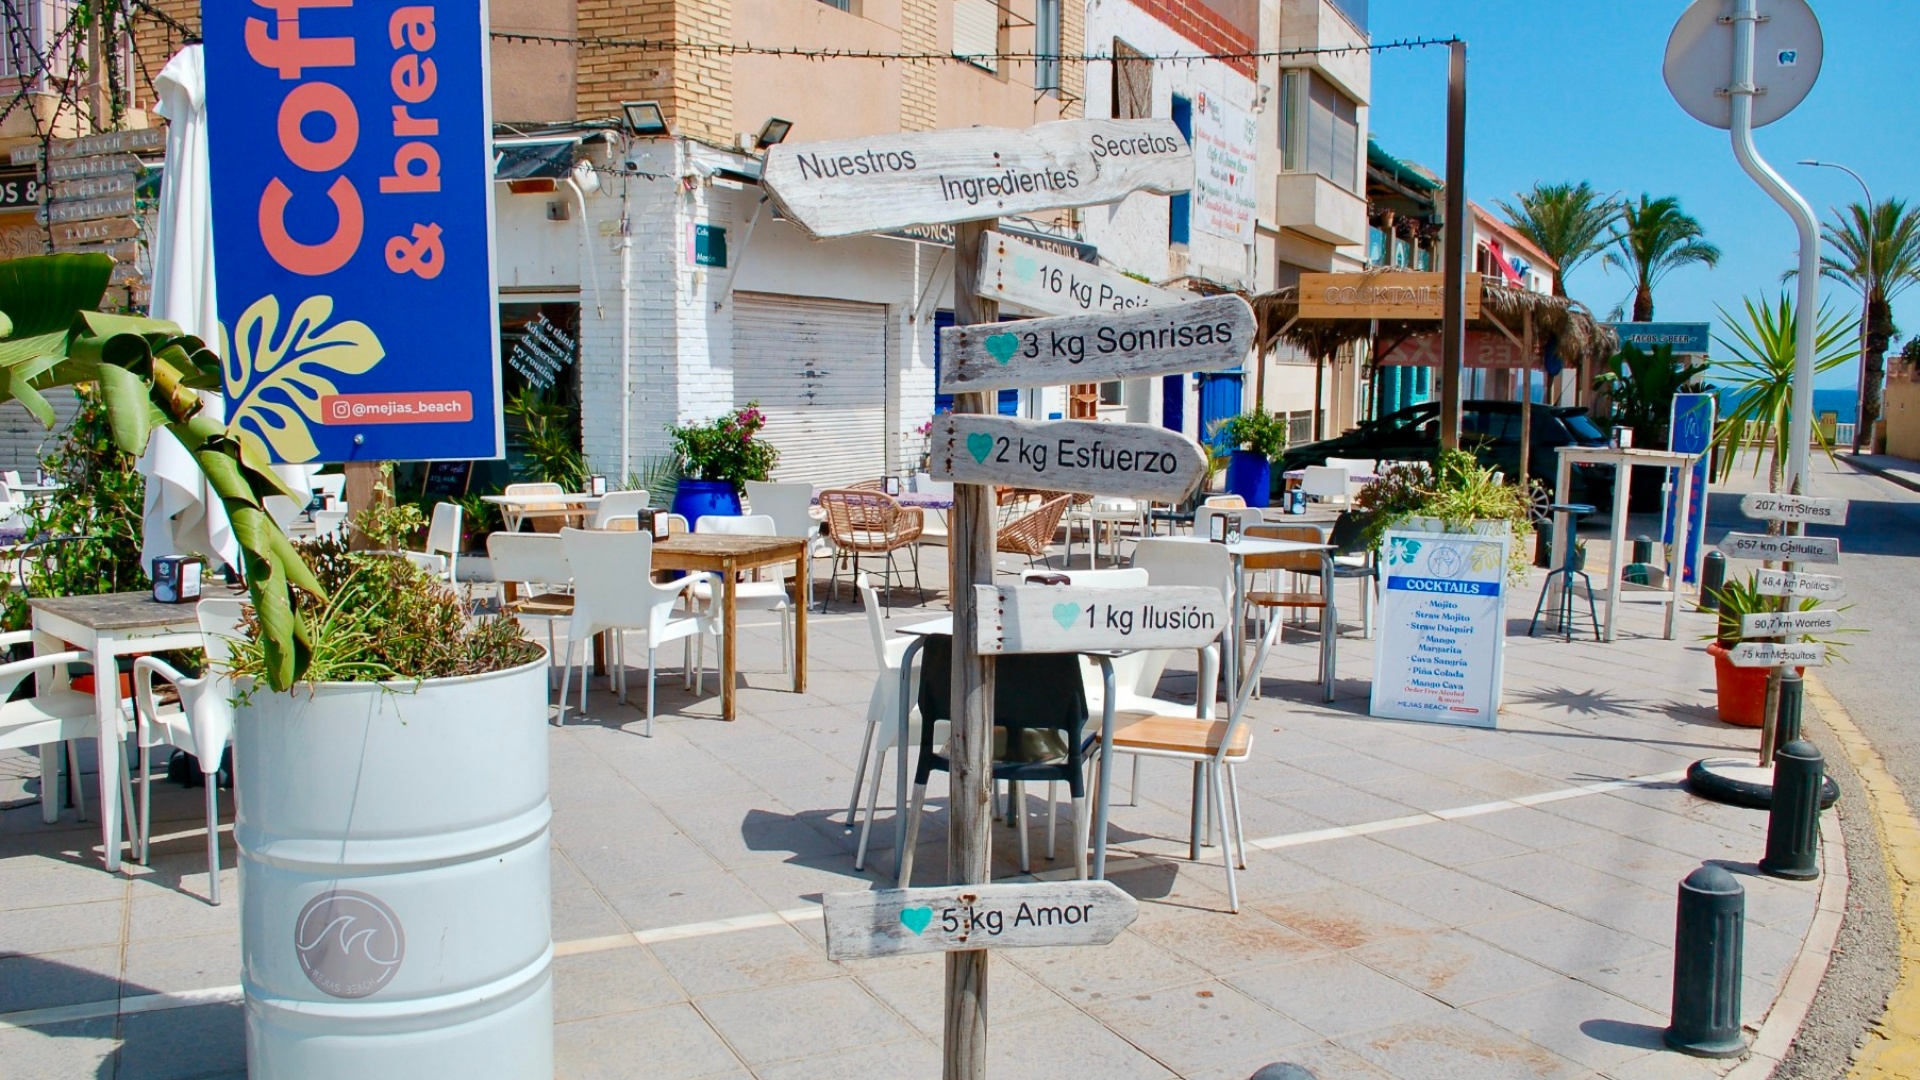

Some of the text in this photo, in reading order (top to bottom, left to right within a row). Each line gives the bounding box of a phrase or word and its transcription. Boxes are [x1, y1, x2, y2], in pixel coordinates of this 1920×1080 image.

[1092, 134, 1178, 157] Secretos
[797, 149, 917, 181] Nuestros
[939, 168, 1079, 206] Ingredientes
[42, 200, 132, 220] ESTAURANT
[66, 226, 108, 240] TAPAS
[385, 222, 445, 279] &
[1040, 266, 1063, 293] 16
[1069, 274, 1092, 309] kg
[524, 320, 565, 358] Adventure
[553, 327, 576, 350] think
[1023, 321, 1232, 364] 3 kg Sonrisas
[513, 344, 527, 359] try
[521, 335, 563, 372] dangerous
[352, 401, 461, 417] @mejias_beach
[996, 436, 1177, 475] 2 kg Esfuerzo
[1755, 500, 1831, 516] 207 km Stress
[1737, 539, 1823, 555] 657 km Cellulite
[1406, 579, 1480, 594] COCKTAILS
[1762, 577, 1830, 591] 48,4 km Politics
[1429, 600, 1458, 610] Mojito
[1086, 604, 1214, 635] 1 kg Ilusión
[1415, 610, 1470, 622] Straw Mojito
[1778, 621, 1793, 629] km
[1795, 619, 1831, 628] Worries
[1410, 622, 1474, 635] Straw Daiquiri
[1425, 635, 1456, 645] Mango
[1418, 643, 1462, 654] Margarita
[1742, 650, 1816, 662] 75 km Mosquitos
[1411, 655, 1432, 664] Cava
[1434, 668, 1464, 678] Colada
[1411, 679, 1464, 690] Mango Cava
[1424, 703, 1448, 711] BEACH
[942, 902, 1093, 935] 5 kg Amor
